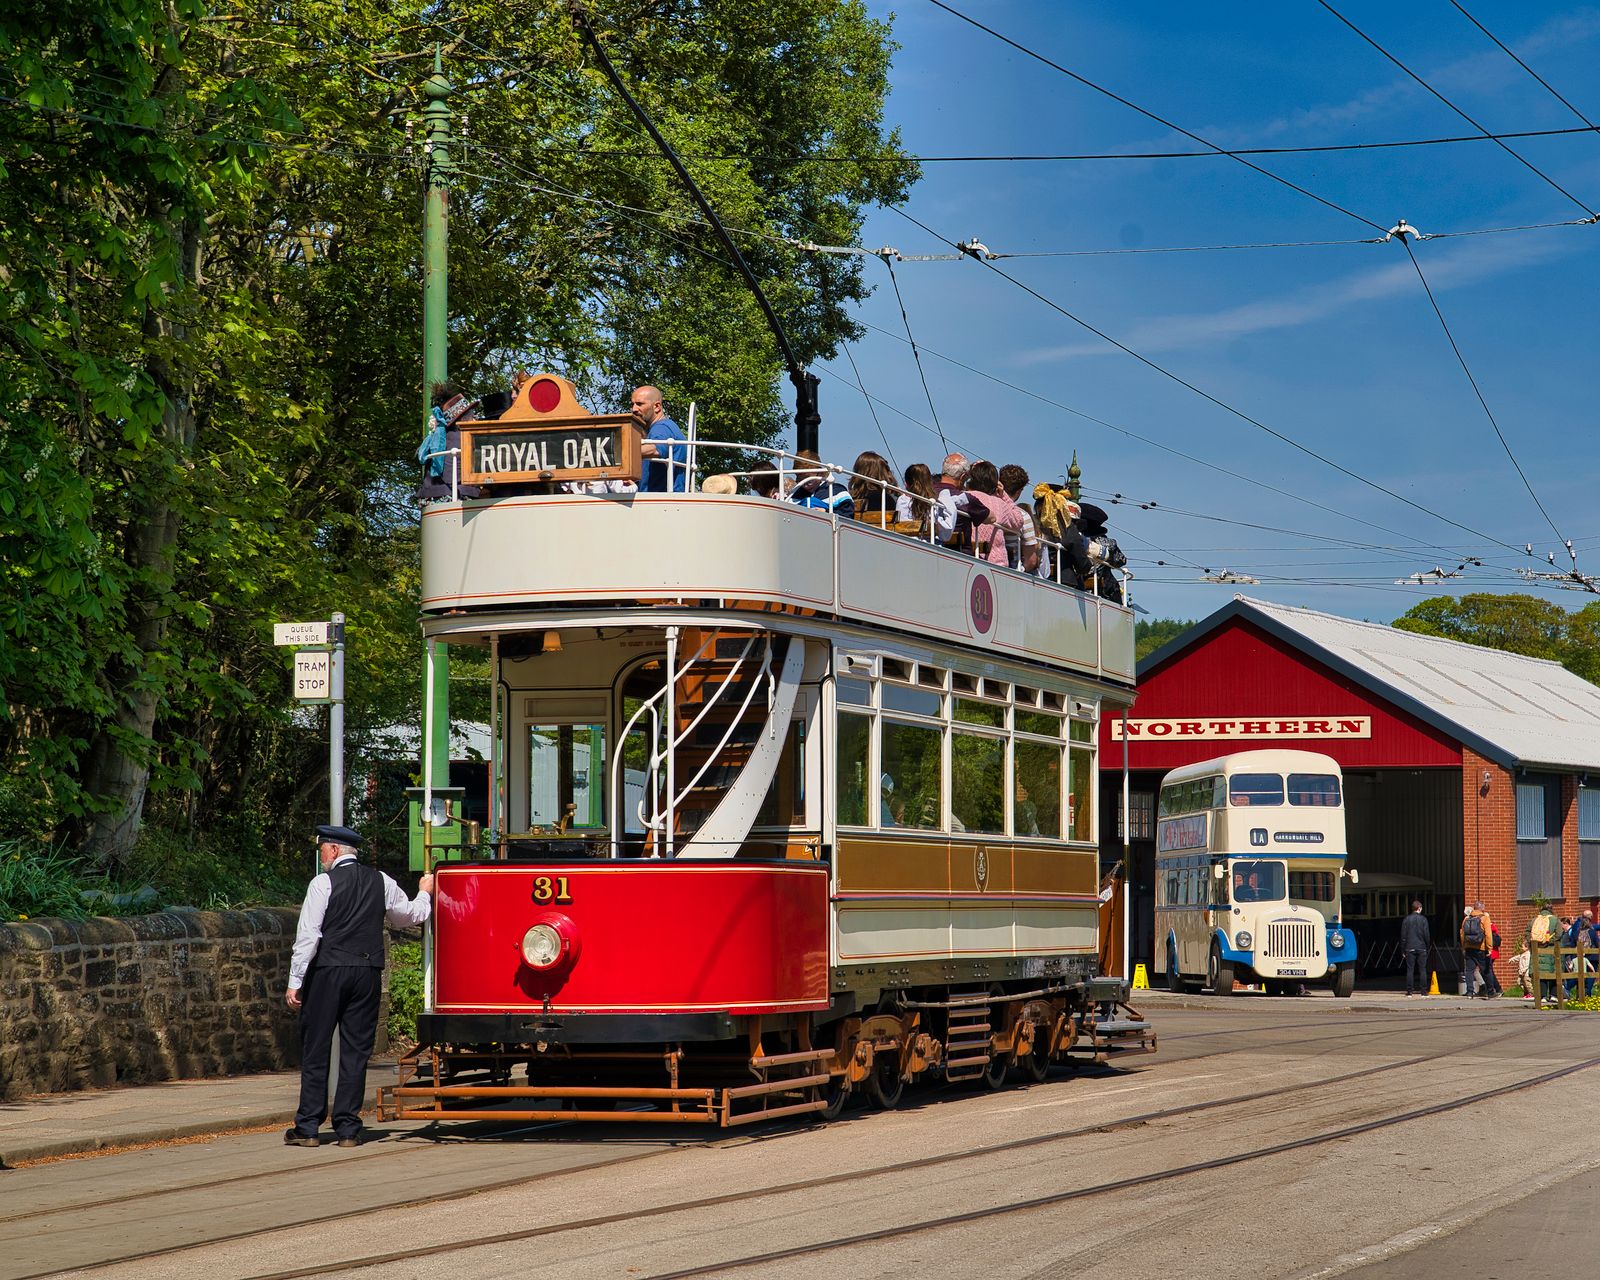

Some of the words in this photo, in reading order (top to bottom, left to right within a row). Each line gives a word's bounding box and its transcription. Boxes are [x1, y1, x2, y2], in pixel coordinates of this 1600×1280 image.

[480, 441, 556, 473] ROYAL
[563, 436, 610, 469] OAK
[975, 588, 988, 615] 31
[297, 662, 326, 671] TRAM
[298, 679, 325, 690] STOP
[1117, 720, 1365, 736] NORTHERN
[533, 876, 572, 903] 31
